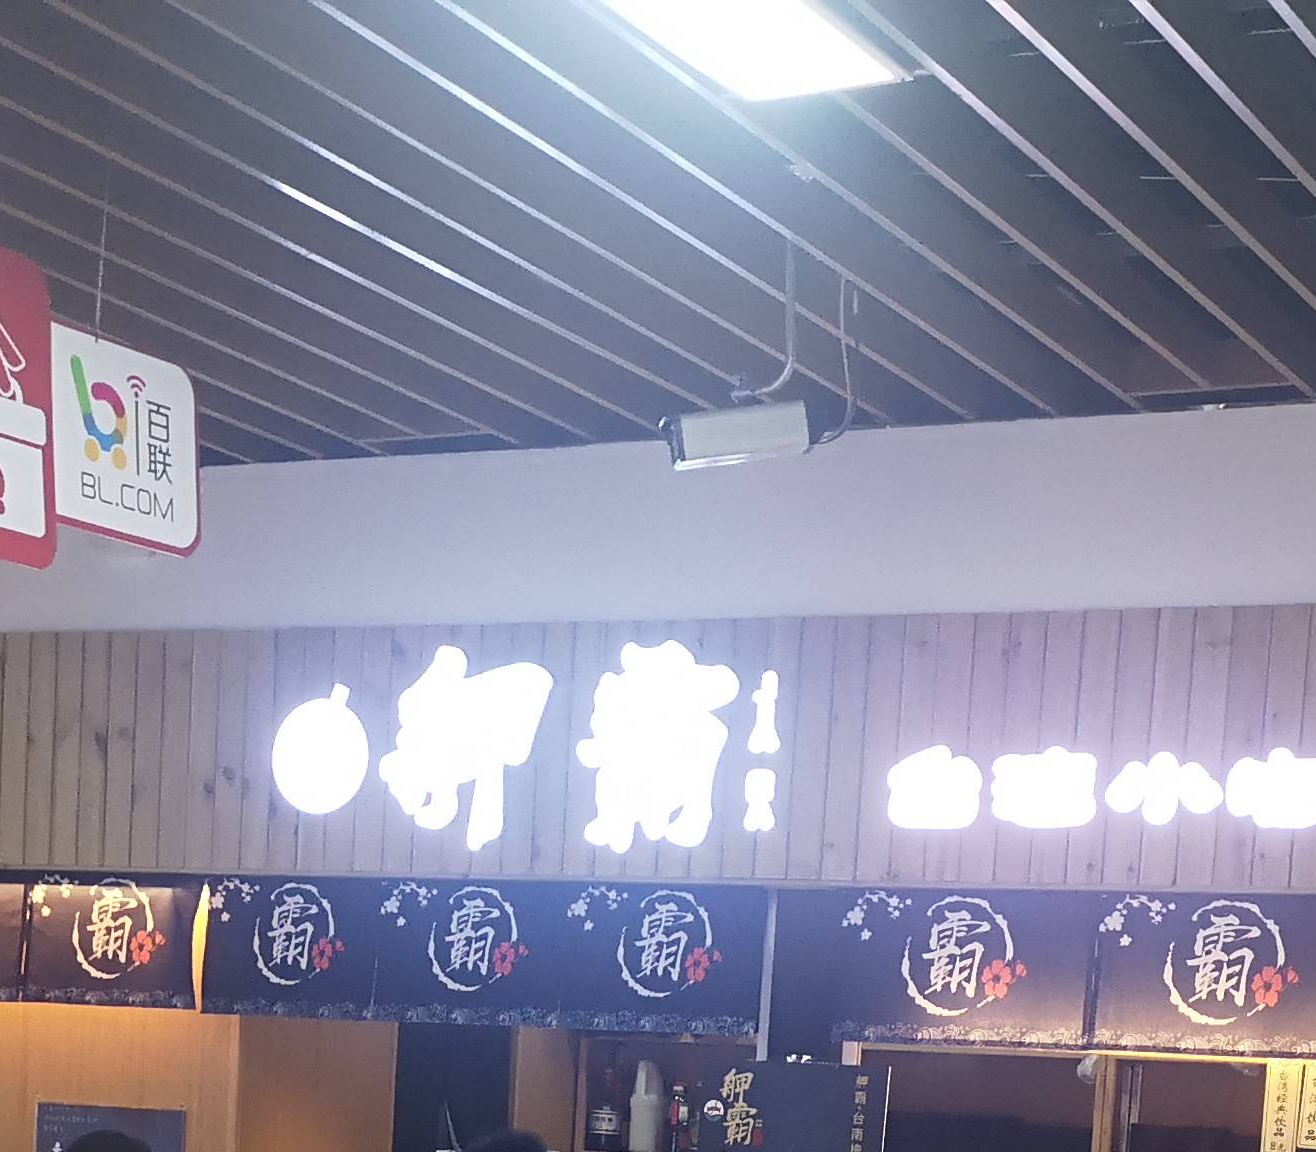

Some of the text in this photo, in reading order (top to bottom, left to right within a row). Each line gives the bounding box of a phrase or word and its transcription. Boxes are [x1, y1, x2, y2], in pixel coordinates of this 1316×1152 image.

[146, 400, 175, 485] 百联
[81, 471, 175, 523] BL.COM
[86, 886, 137, 961] 霸
[268, 896, 316, 971] 霸
[445, 898, 496, 977] 霸
[633, 902, 692, 982] 霸
[922, 909, 983, 996] 霸
[1188, 916, 1262, 1006] 霸
[719, 1068, 758, 1146] 舺霸
